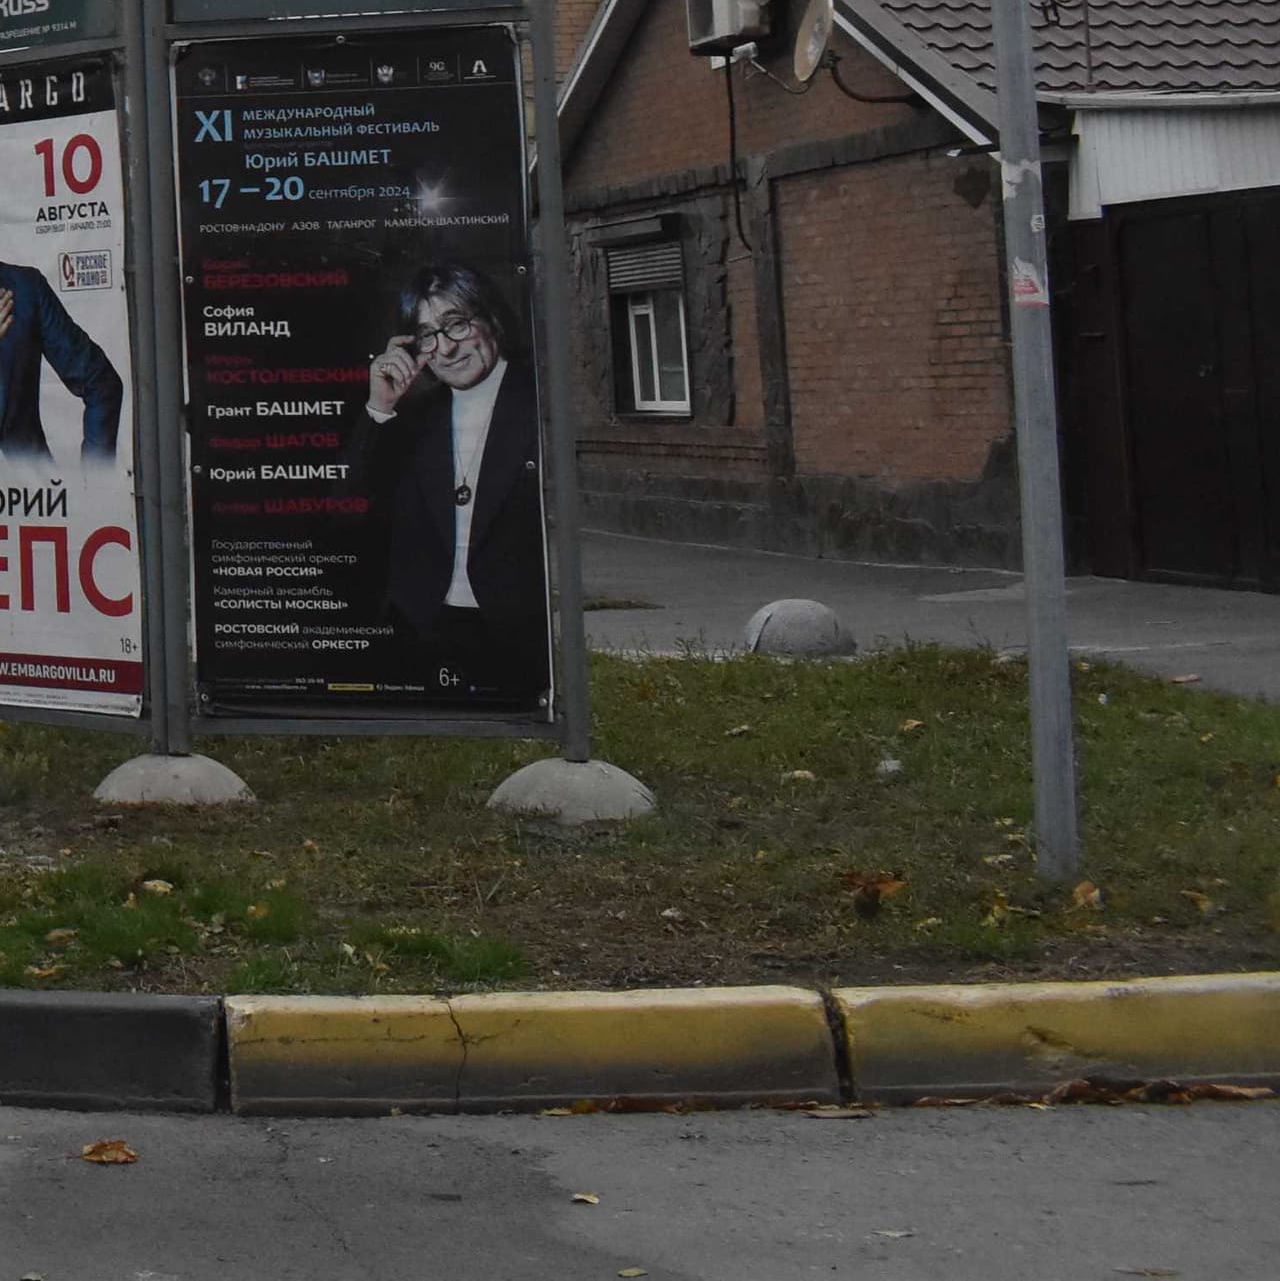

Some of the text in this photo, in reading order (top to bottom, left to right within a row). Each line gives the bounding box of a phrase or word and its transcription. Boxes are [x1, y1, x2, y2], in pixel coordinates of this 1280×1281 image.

[194, 103, 376, 143] XI МЕЖДУНАРОДНЫЙ
[243, 120, 440, 140] МУЗЫКАЛЬНЫЙ ФЕСТИВАЛЬ
[33, 133, 103, 197] 10
[245, 149, 392, 172] Юрий БАШМЕТ
[308, 186, 375, 201] сентября
[378, 185, 411, 198] 2024
[36, 201, 110, 223] АВГУСТА
[199, 221, 285, 234] РОСТОВ-НА-ДОНУ
[291, 220, 320, 232] АЗОВ
[327, 218, 376, 230] ТАГАНРОГ
[203, 305, 255, 319] София
[204, 321, 291, 338] ВИЛАНД
[207, 400, 345, 418] Грант БАШМЕТ
[209, 464, 350, 482] Юрий БАШМЕТ
[211, 539, 313, 552] Государственный
[211, 552, 357, 565] симфонический оркестр
[212, 566, 324, 577] «НОВАЯ РОССИЯ»
[213, 586, 333, 598] Камерный ансамбль
[213, 599, 349, 610] «СОЛИСТЫ МОСКВЫ»
[214, 622, 394, 636] РОСТОВСКИЙ академический
[119, 637, 138, 654] 18+
[214, 638, 370, 651] симфонический ОРКЕСТР
[440, 668, 460, 687] 6+
